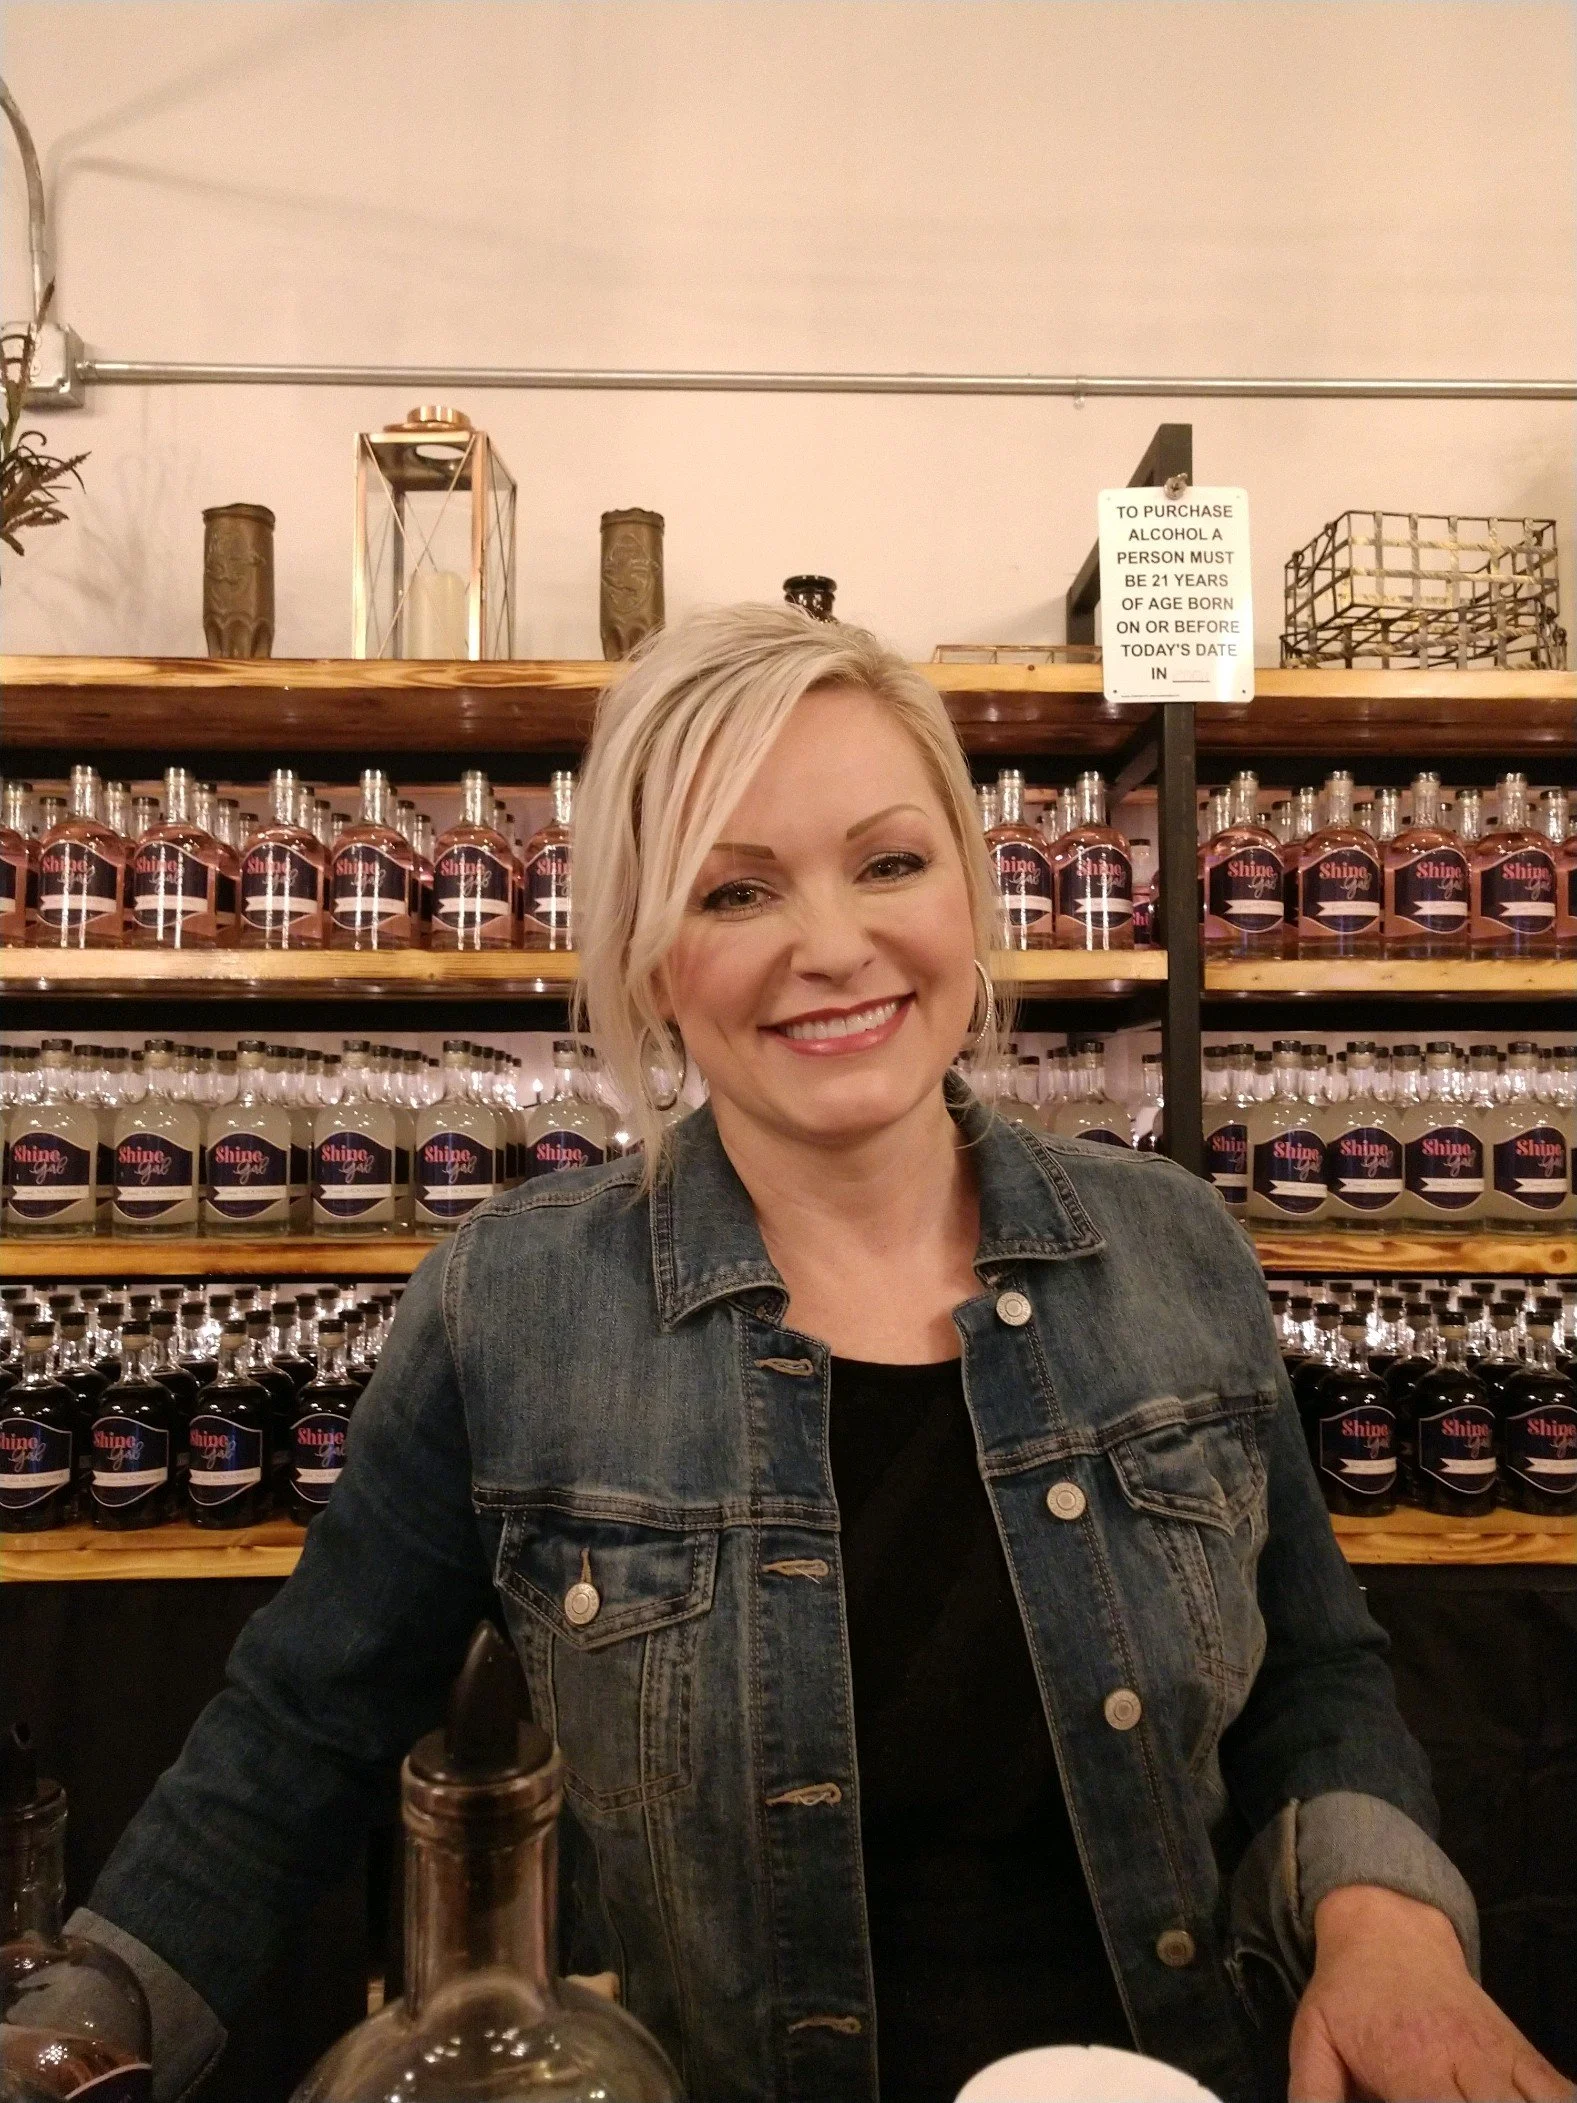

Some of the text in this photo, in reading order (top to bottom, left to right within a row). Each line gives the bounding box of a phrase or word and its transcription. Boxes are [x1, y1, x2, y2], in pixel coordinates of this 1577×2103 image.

[1117, 504, 1233, 519] TO PURCHASE
[1128, 528, 1223, 542] ALCOHOL A
[1117, 551, 1235, 565] PERSON MUST
[1125, 574, 1229, 588] BE 21 YEARS
[1121, 597, 1234, 611] OF AGE BORN
[1116, 620, 1241, 634] ON OR BEFORE
[1121, 643, 1238, 657] TODAY'S DATE
[1151, 667, 1167, 680] IN
[1228, 860, 1274, 878] Shine
[1319, 861, 1368, 879] Shine
[1416, 861, 1461, 878] Shine
[1502, 862, 1549, 880] Shine
[536, 1143, 582, 1162] Shine
[1212, 1135, 1247, 1152] Shin
[1274, 1141, 1320, 1160] Shine
[1340, 1139, 1389, 1157] Shine
[1422, 1139, 1472, 1157] Shine
[1516, 1139, 1562, 1157] Shine
[14, 1145, 61, 1163] Shine
[118, 1145, 164, 1164] Shine
[215, 1145, 263, 1164] Shine
[321, 1144, 368, 1162] Shine
[424, 1145, 471, 1163] Shine
[297, 1427, 344, 1446] Shine
[1342, 1419, 1389, 1437] Shine
[1441, 1419, 1489, 1437] Shine
[92, 1430, 136, 1449] Shine
[190, 1429, 229, 1448] Shine
